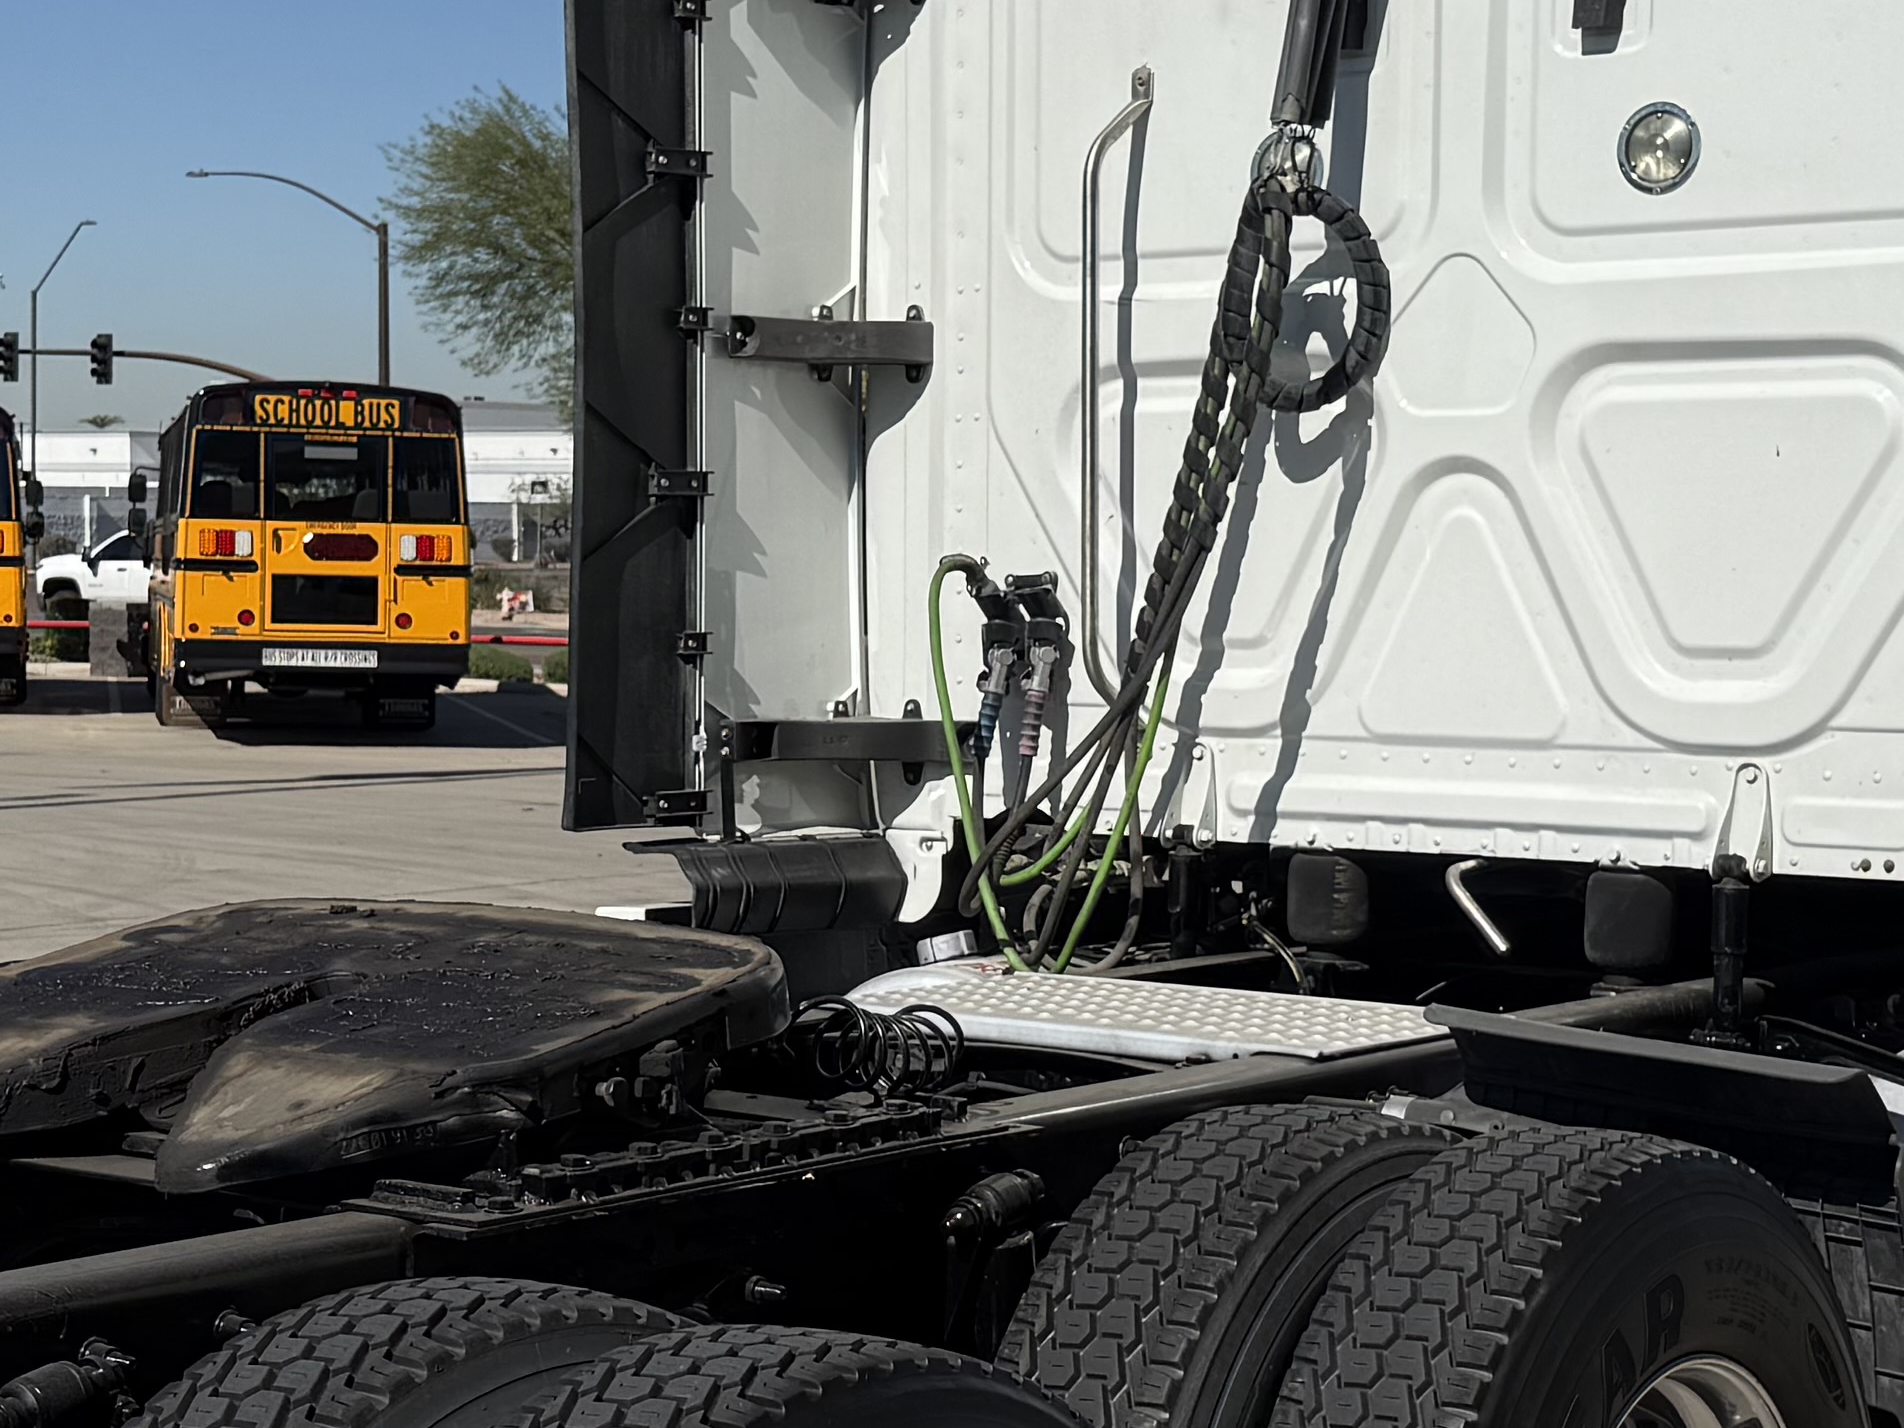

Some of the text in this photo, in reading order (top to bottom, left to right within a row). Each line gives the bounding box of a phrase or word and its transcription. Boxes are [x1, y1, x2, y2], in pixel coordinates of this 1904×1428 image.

[259, 397, 396, 428] SCHOOL BUS
[264, 649, 277, 662] BUS
[279, 649, 299, 663] STOPS
[301, 650, 309, 663] AT
[311, 650, 321, 663] ALL
[340, 651, 377, 665] CROSSINGS
